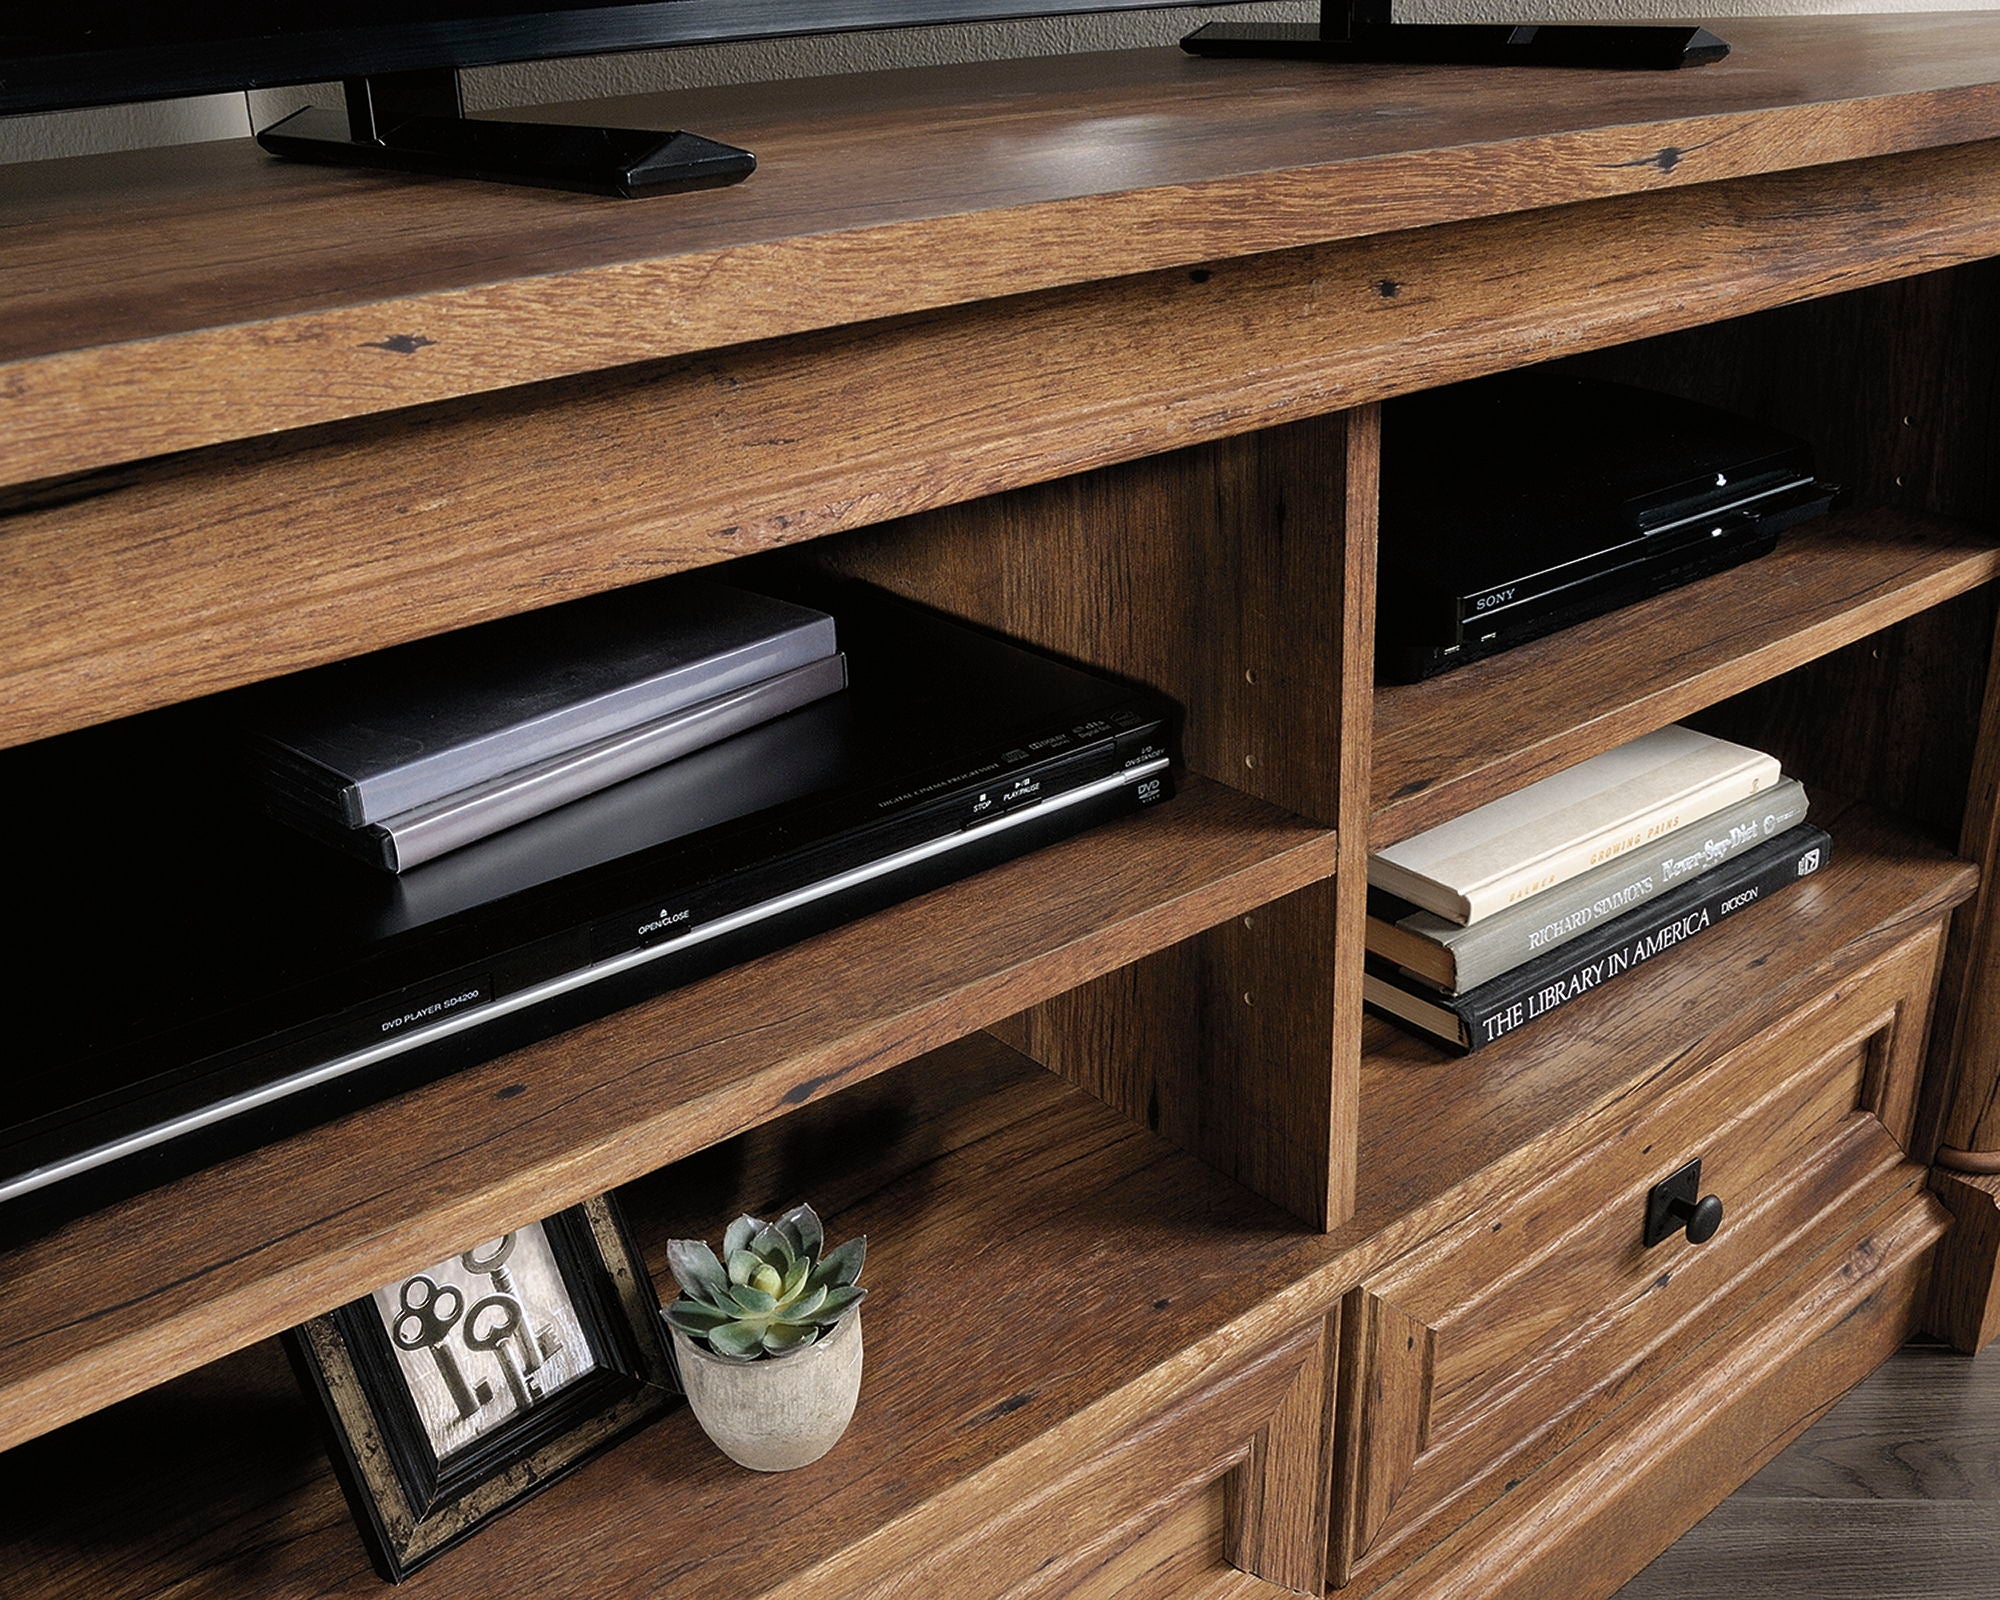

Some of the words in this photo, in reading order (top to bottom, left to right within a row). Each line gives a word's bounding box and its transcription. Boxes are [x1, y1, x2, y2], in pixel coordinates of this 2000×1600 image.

[1476, 588, 1516, 611] SONY
[1137, 779, 1160, 795] DVD
[973, 800, 992, 813] STOP
[1589, 834, 1641, 866] GROWING
[1646, 815, 1680, 840] PAINS
[638, 909, 690, 935] OPEN/CLOSE
[1528, 907, 1592, 951] RICHARD
[1593, 876, 1654, 919] SIMMONS
[1482, 1002, 1524, 1042] THE
[1528, 959, 1605, 1019] LIBRARY
[1607, 947, 1630, 978] IN
[1631, 907, 1711, 966] AMERICA
[1720, 886, 1759, 915] DICKSON
[381, 1018, 403, 1032] DVD
[404, 1003, 442, 1023] PLAYER
[443, 989, 480, 1009] SD4200
